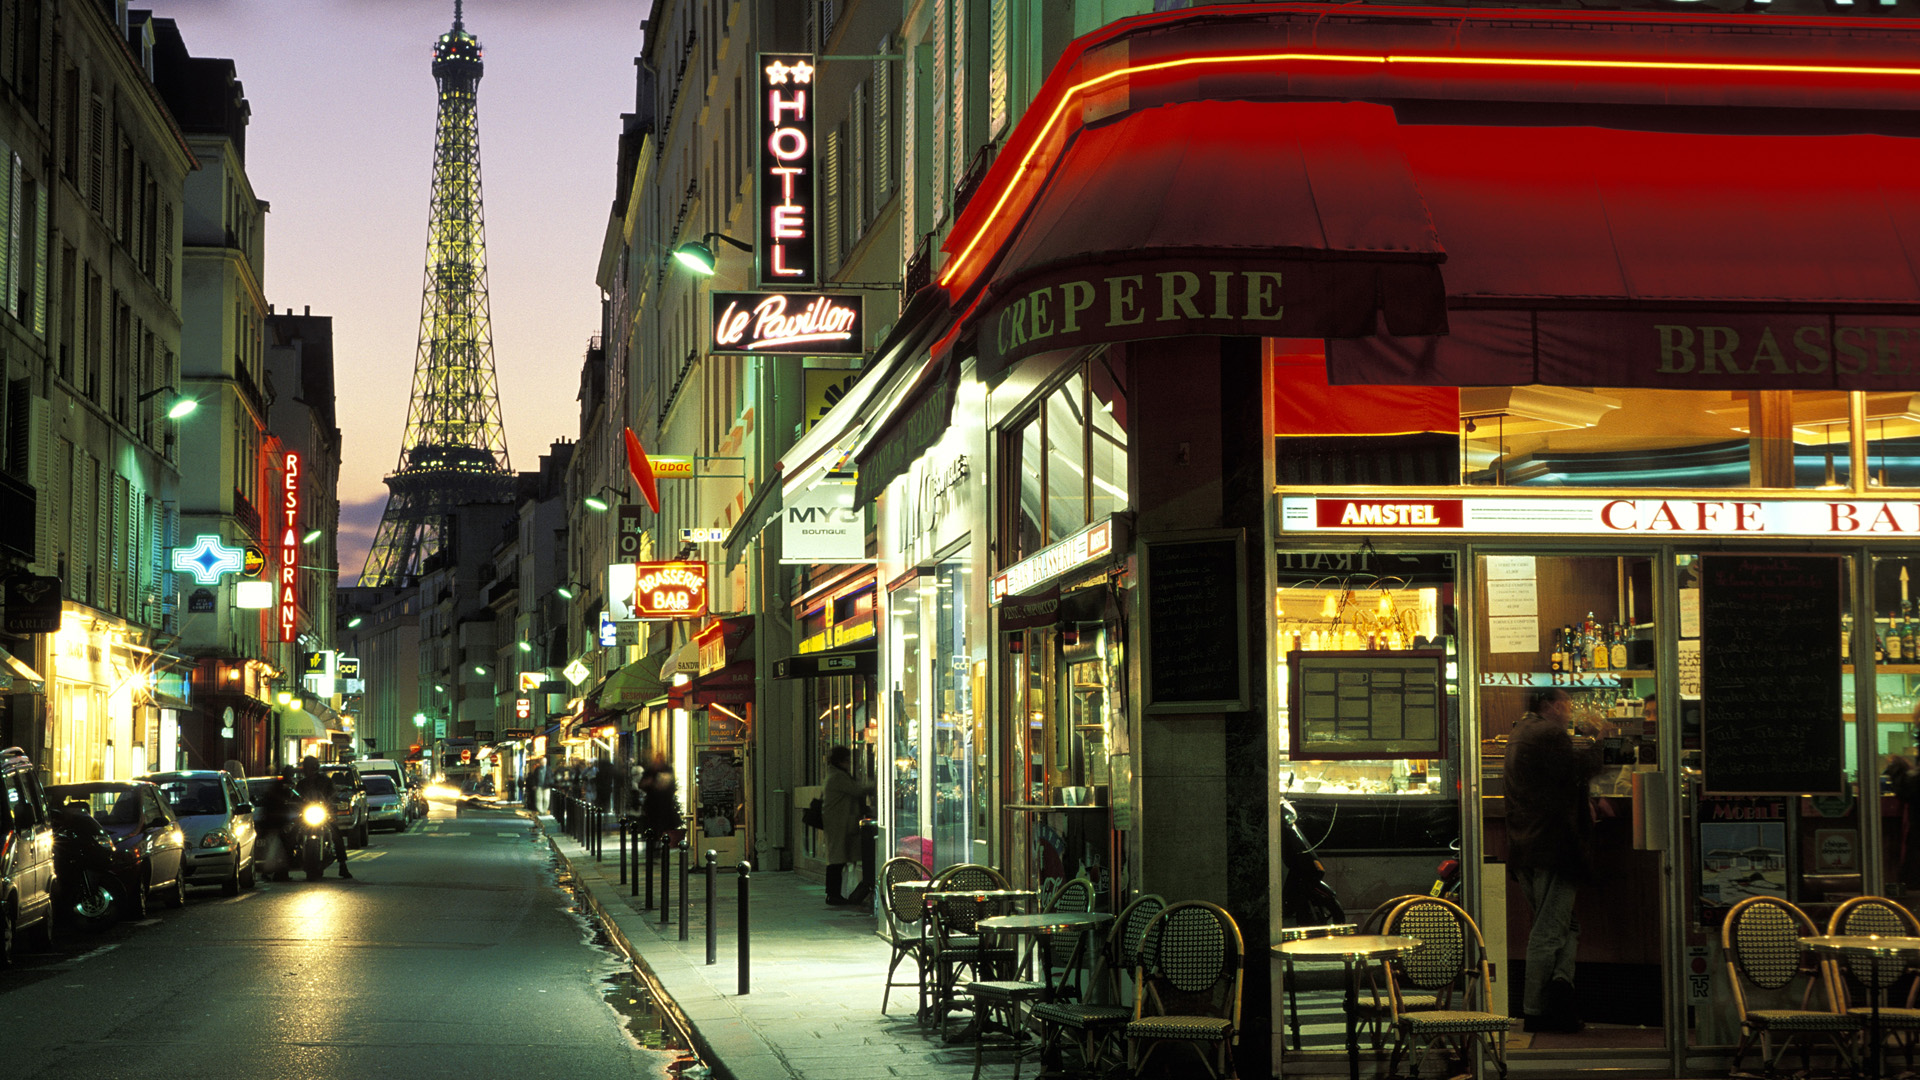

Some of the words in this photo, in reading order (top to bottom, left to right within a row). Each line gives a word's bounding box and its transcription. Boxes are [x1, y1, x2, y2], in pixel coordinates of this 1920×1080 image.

[769, 89, 807, 277] HOTEL
[717, 299, 746, 346] Le
[750, 295, 857, 340] Pavillon
[998, 271, 1284, 356] CREPERIE
[1653, 324, 1920, 376] BRASSE
[653, 461, 691, 472] Tabac
[1341, 502, 1440, 526] AMSTEL
[1600, 500, 1765, 532] CAFE
[1828, 502, 1920, 532] BA
[282, 454, 298, 640] RESTAURANT
[1032, 538, 1079, 583] BRASSERIE
[638, 568, 705, 595] BRASSERIE
[654, 591, 689, 611] BAR
[339, 664, 357, 673] CCF
[954, 662, 970, 670] CCF
[1480, 672, 1534, 685] BAR
[1552, 672, 1621, 686] BRAS
[1712, 802, 1786, 820] MOBILE
